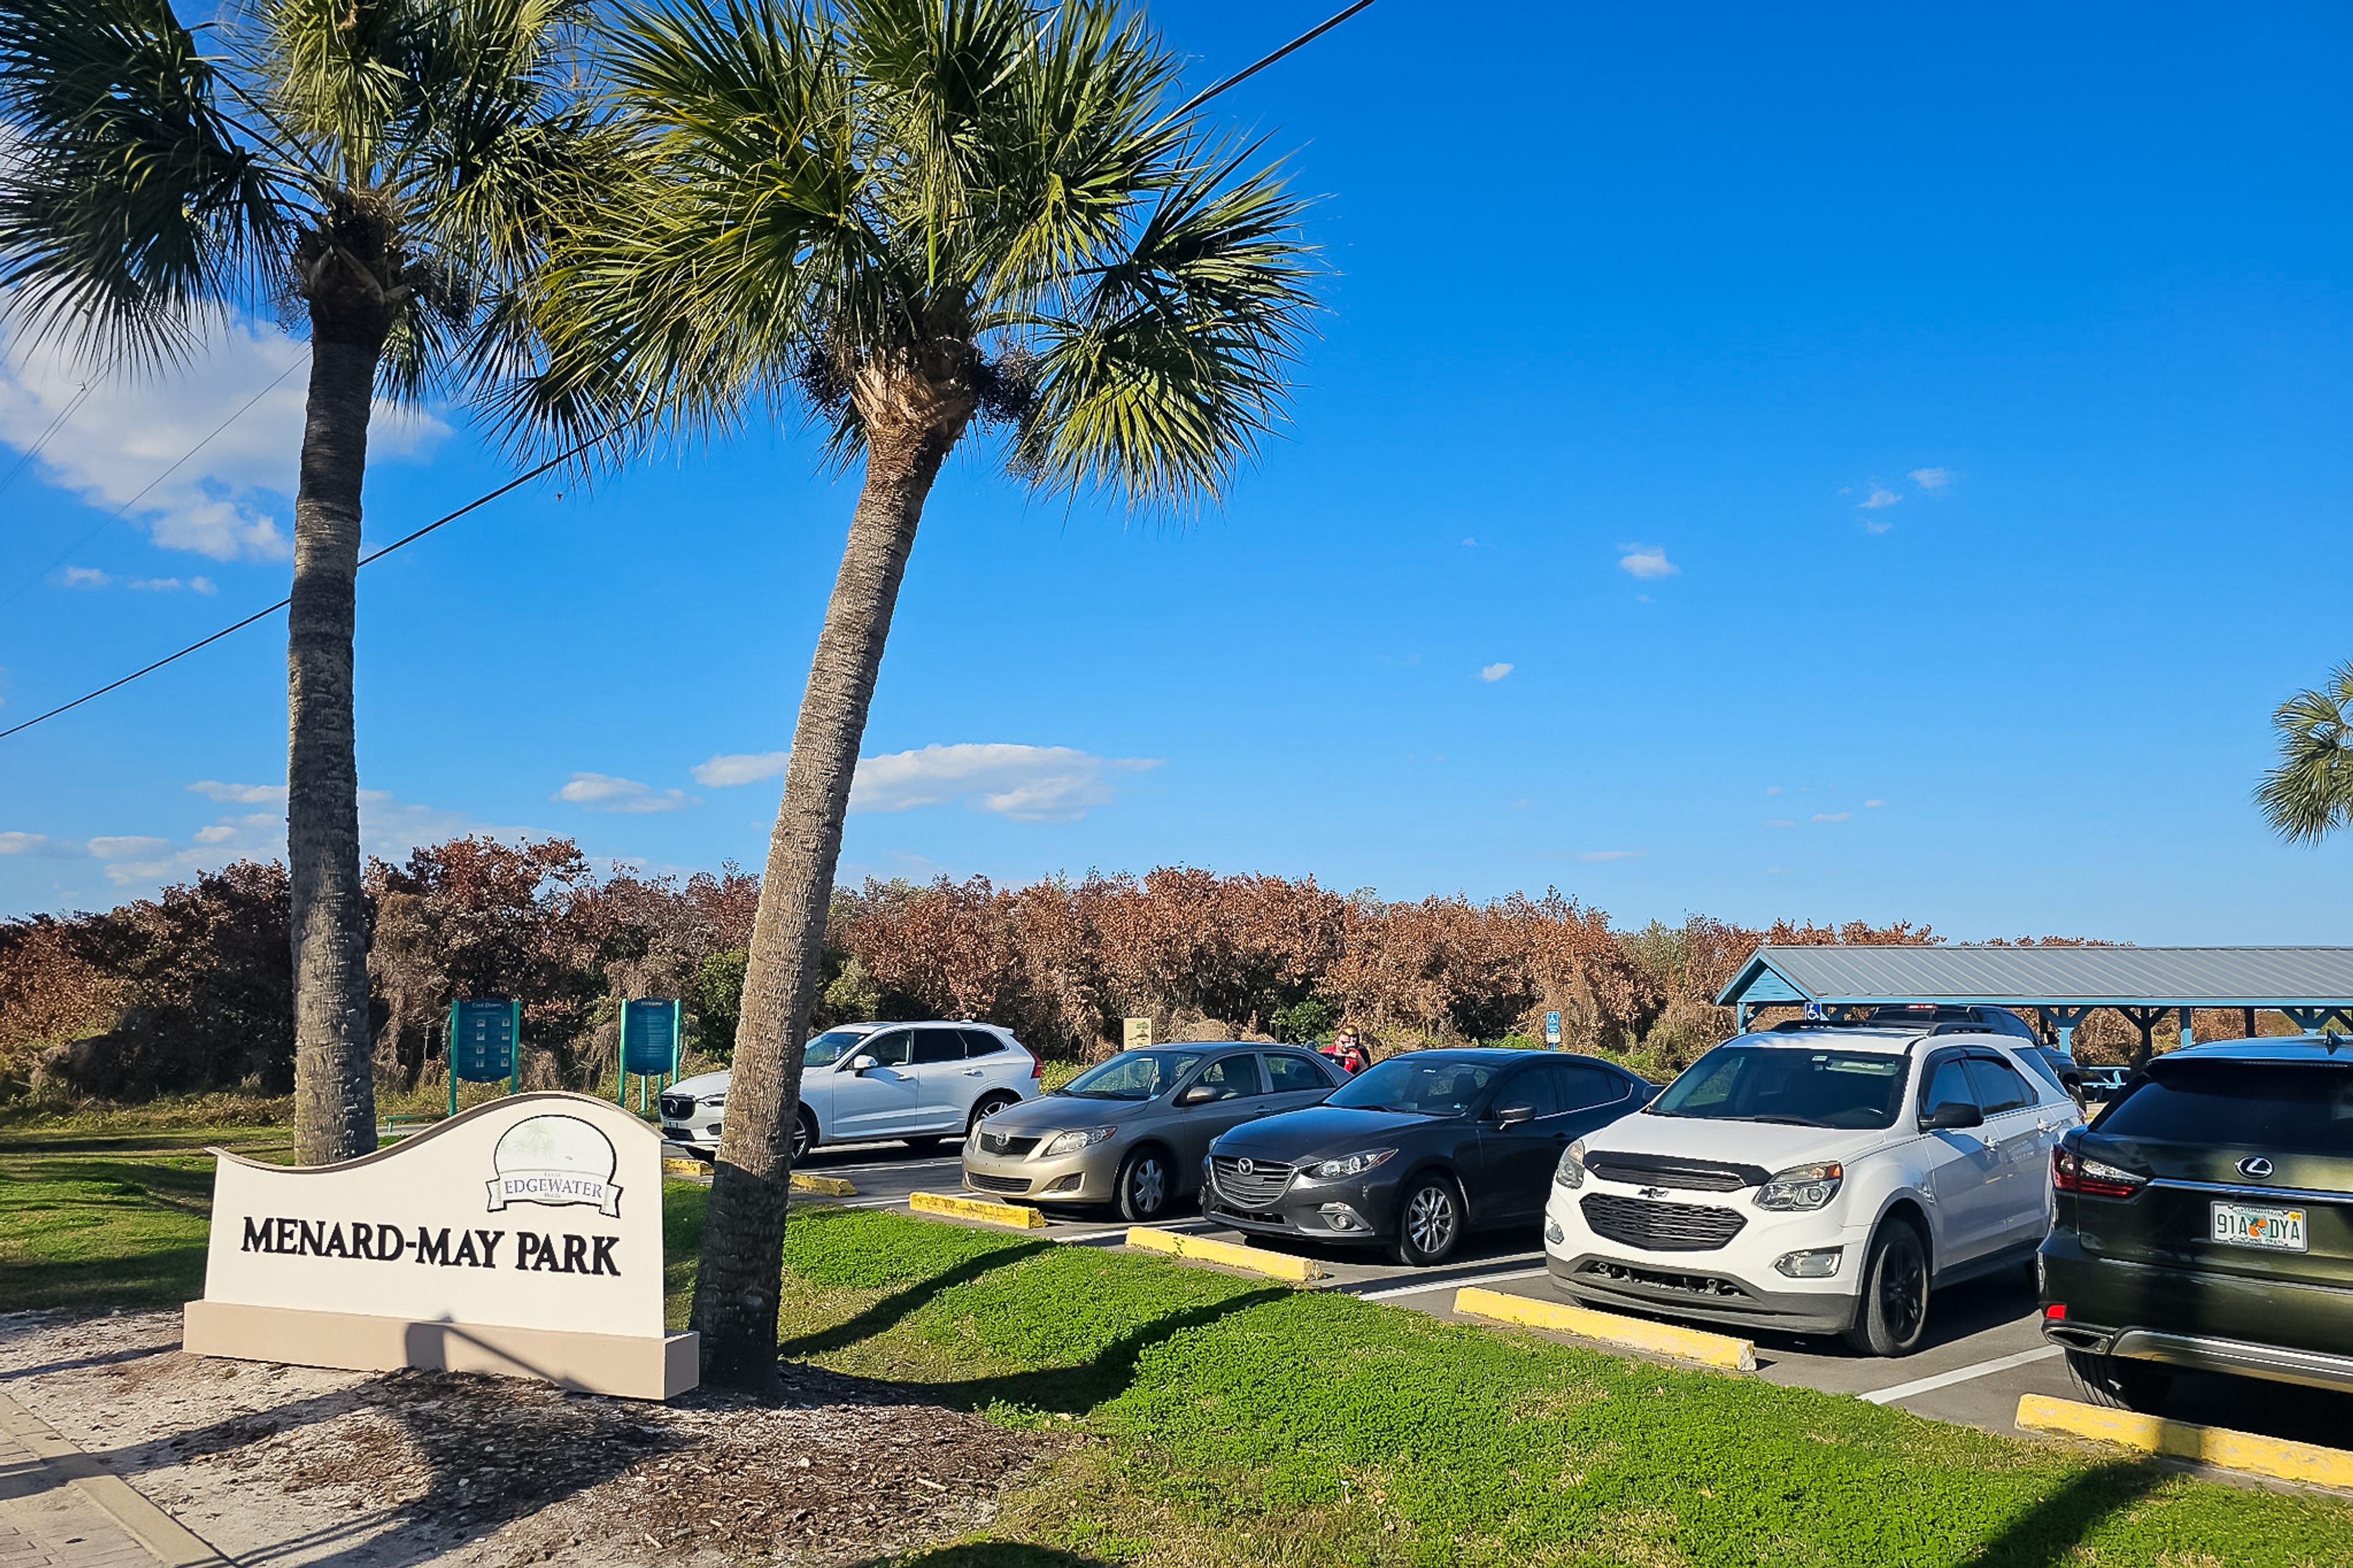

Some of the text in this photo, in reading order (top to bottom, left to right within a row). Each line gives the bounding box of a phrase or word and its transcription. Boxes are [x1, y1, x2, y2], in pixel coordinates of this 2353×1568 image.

[504, 1178, 602, 1198] EDGEWATER
[2217, 1213, 2248, 1235] 91A
[2269, 1218, 2300, 1241] DYA
[240, 1216, 621, 1276] MENARD-MAY PARK
